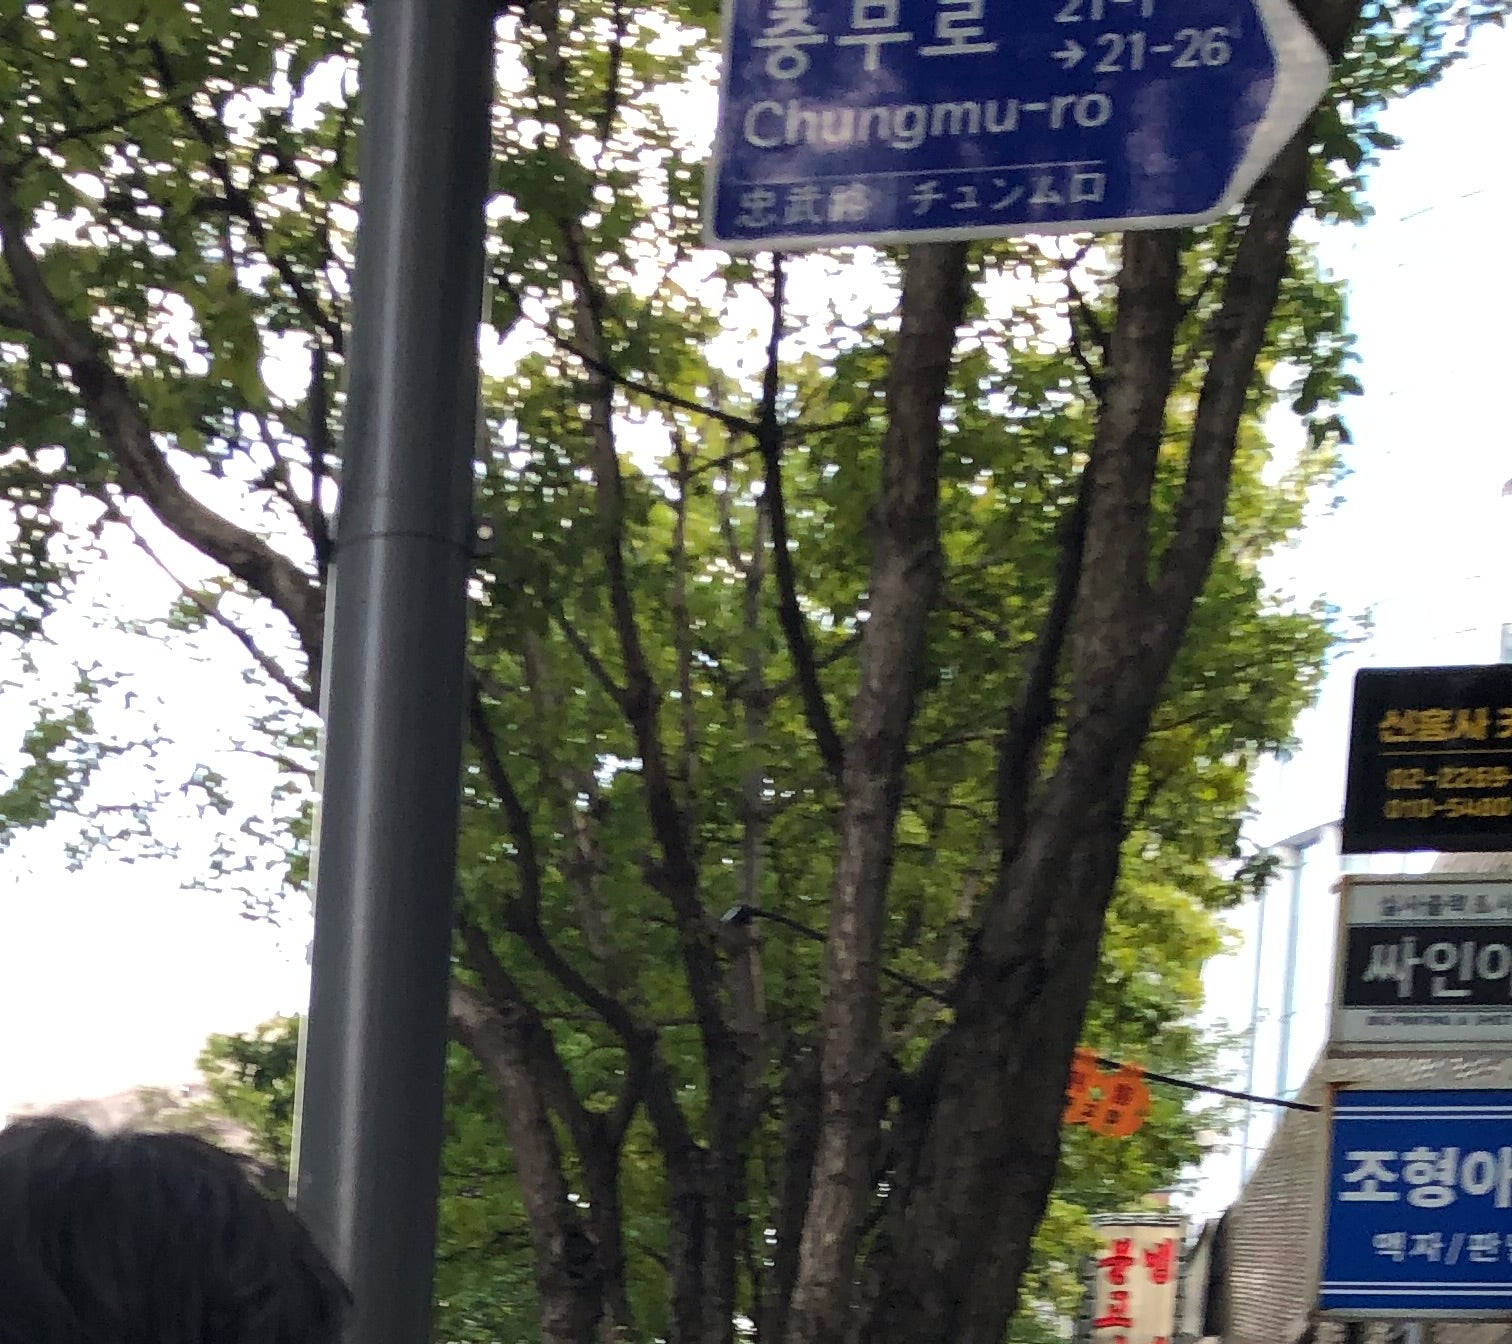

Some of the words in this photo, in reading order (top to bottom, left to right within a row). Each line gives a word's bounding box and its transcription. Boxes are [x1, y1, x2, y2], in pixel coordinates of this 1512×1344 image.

[751, 0, 1000, 80] 충무로
[1094, 26, 1233, 72] 21-26
[744, 92, 1114, 150] Chungmu-ro
